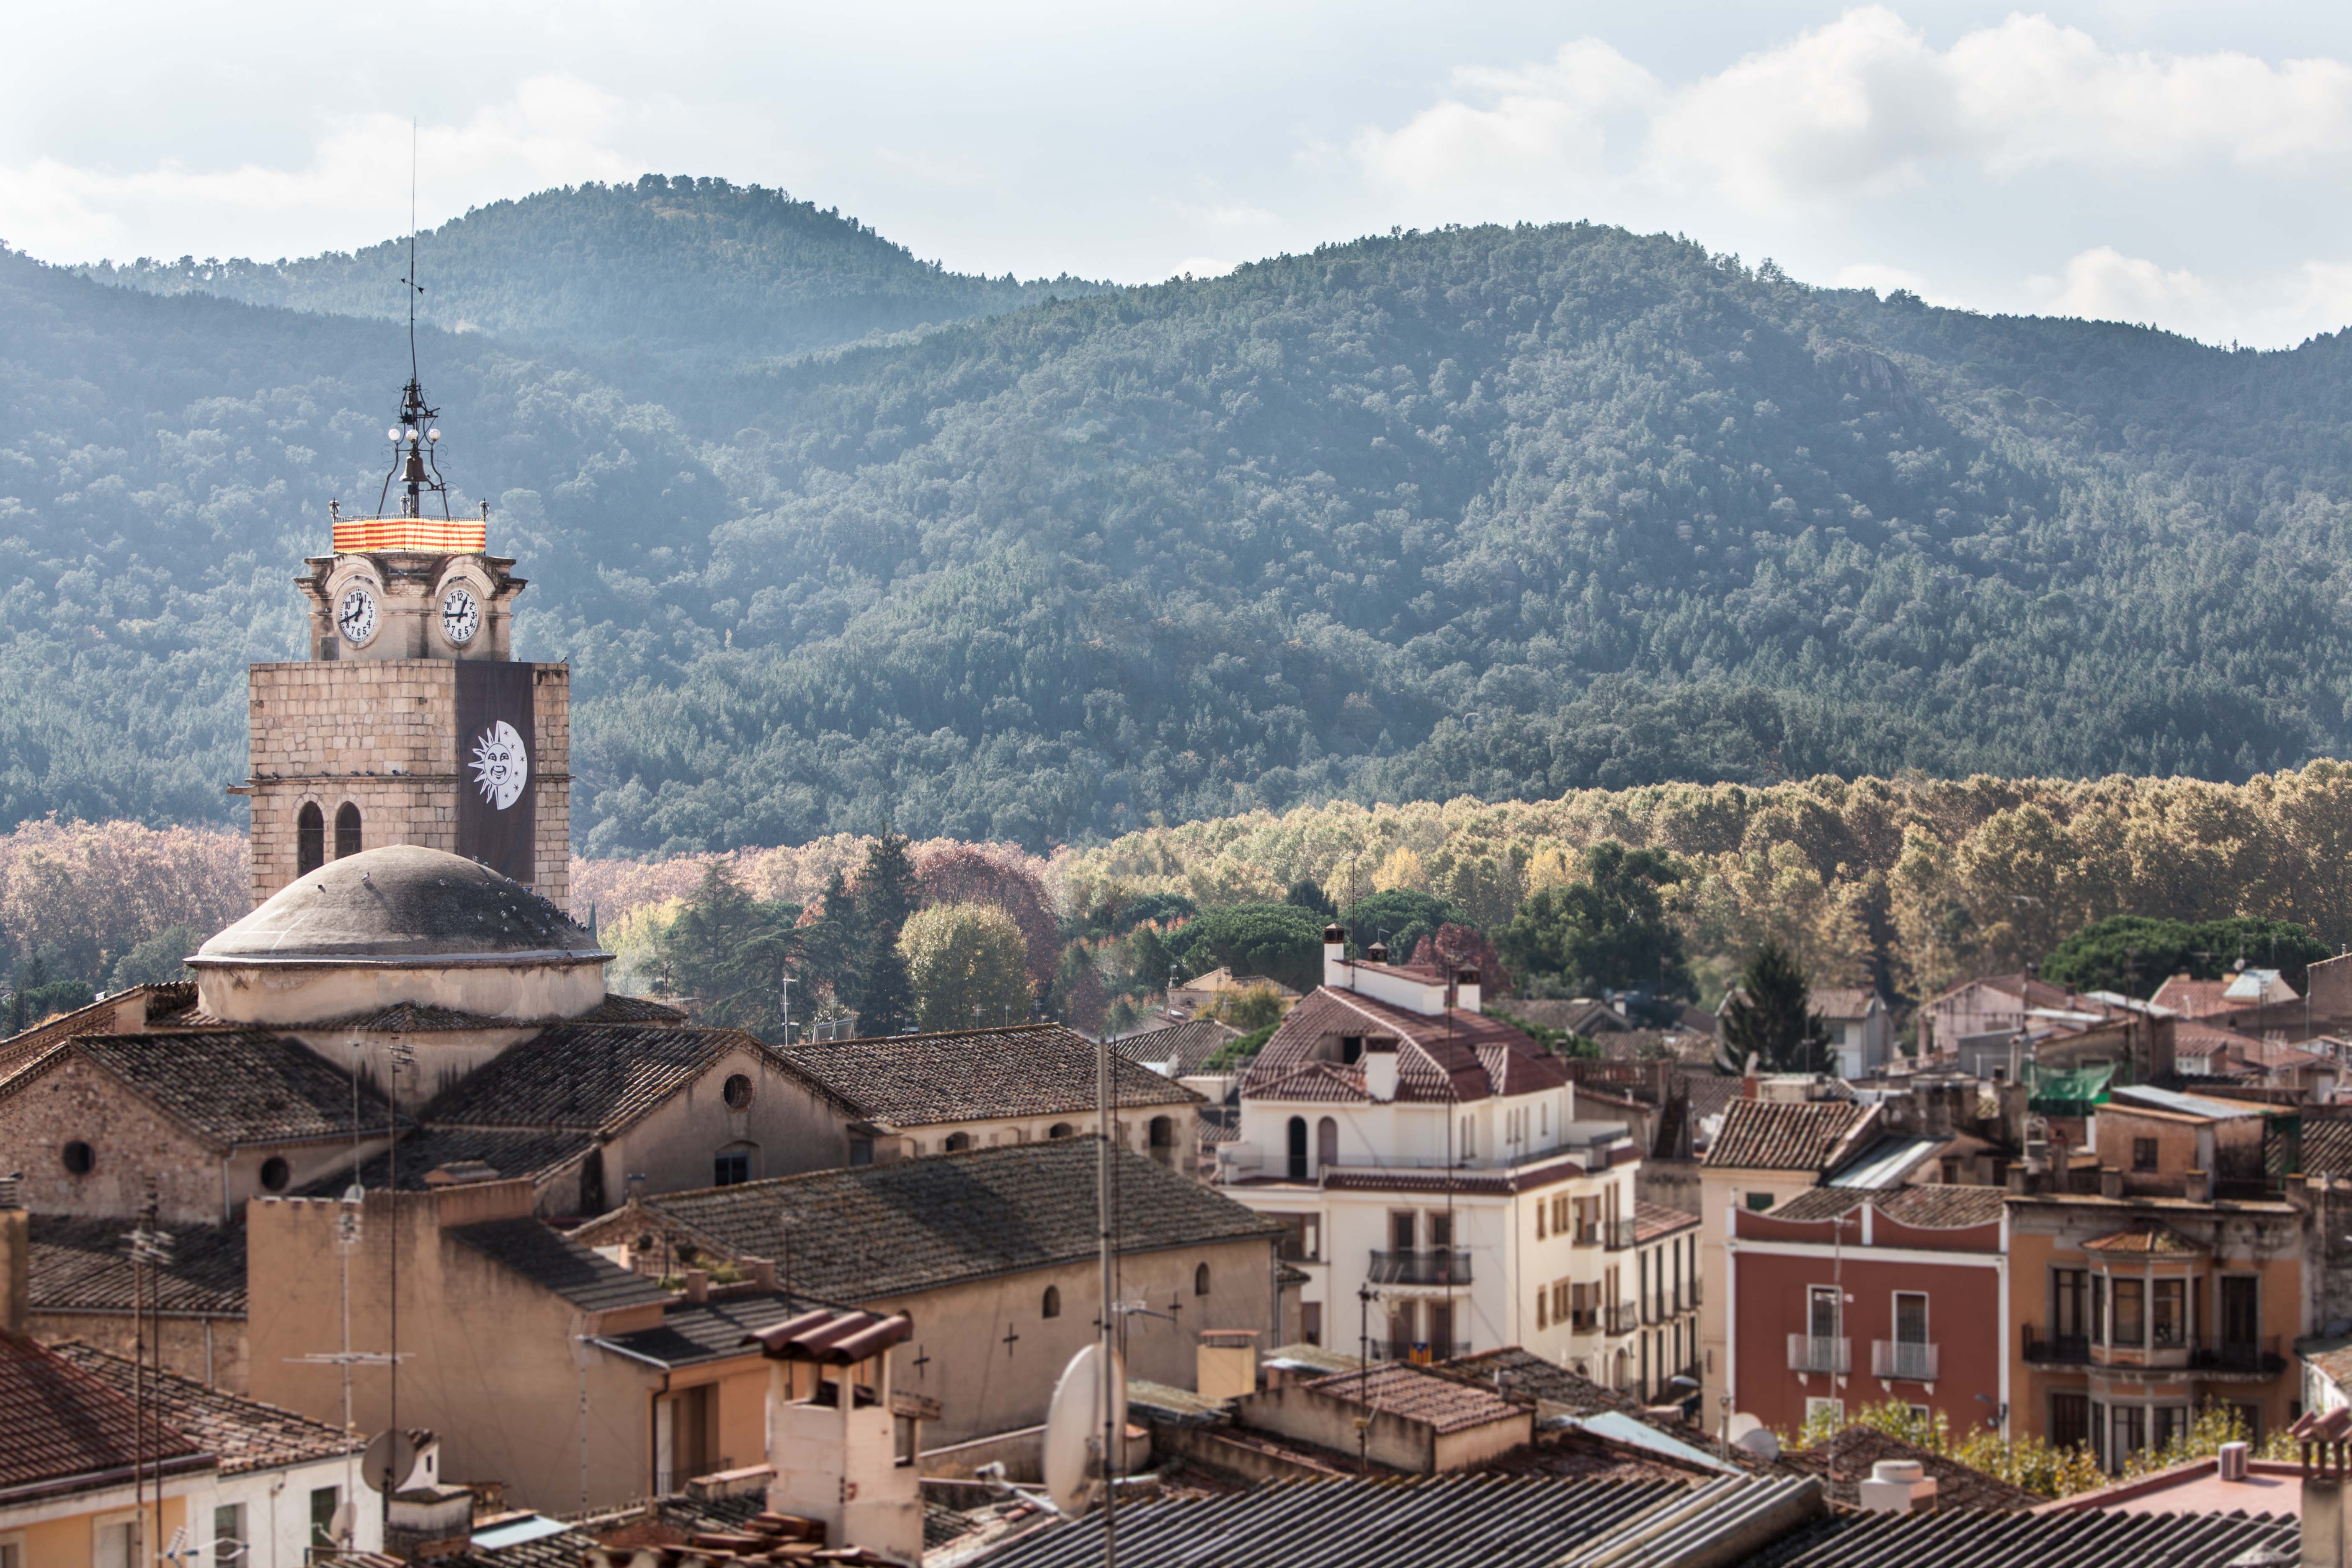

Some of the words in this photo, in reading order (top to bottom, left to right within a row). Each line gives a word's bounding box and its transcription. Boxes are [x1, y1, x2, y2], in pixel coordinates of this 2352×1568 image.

[351, 594, 355, 603] 11
[364, 594, 366, 603] 1
[451, 595, 456, 603] 11
[457, 593, 463, 601] 12
[368, 601, 371, 609] 2
[446, 602, 452, 611] 10
[369, 610, 373, 619] 3
[366, 620, 371, 629] 4
[447, 619, 450, 628] 8
[469, 620, 474, 628] 4
[352, 626, 356, 634] 7
[357, 628, 361, 637] 6
[363, 627, 366, 635] 5
[452, 625, 455, 634] 7
